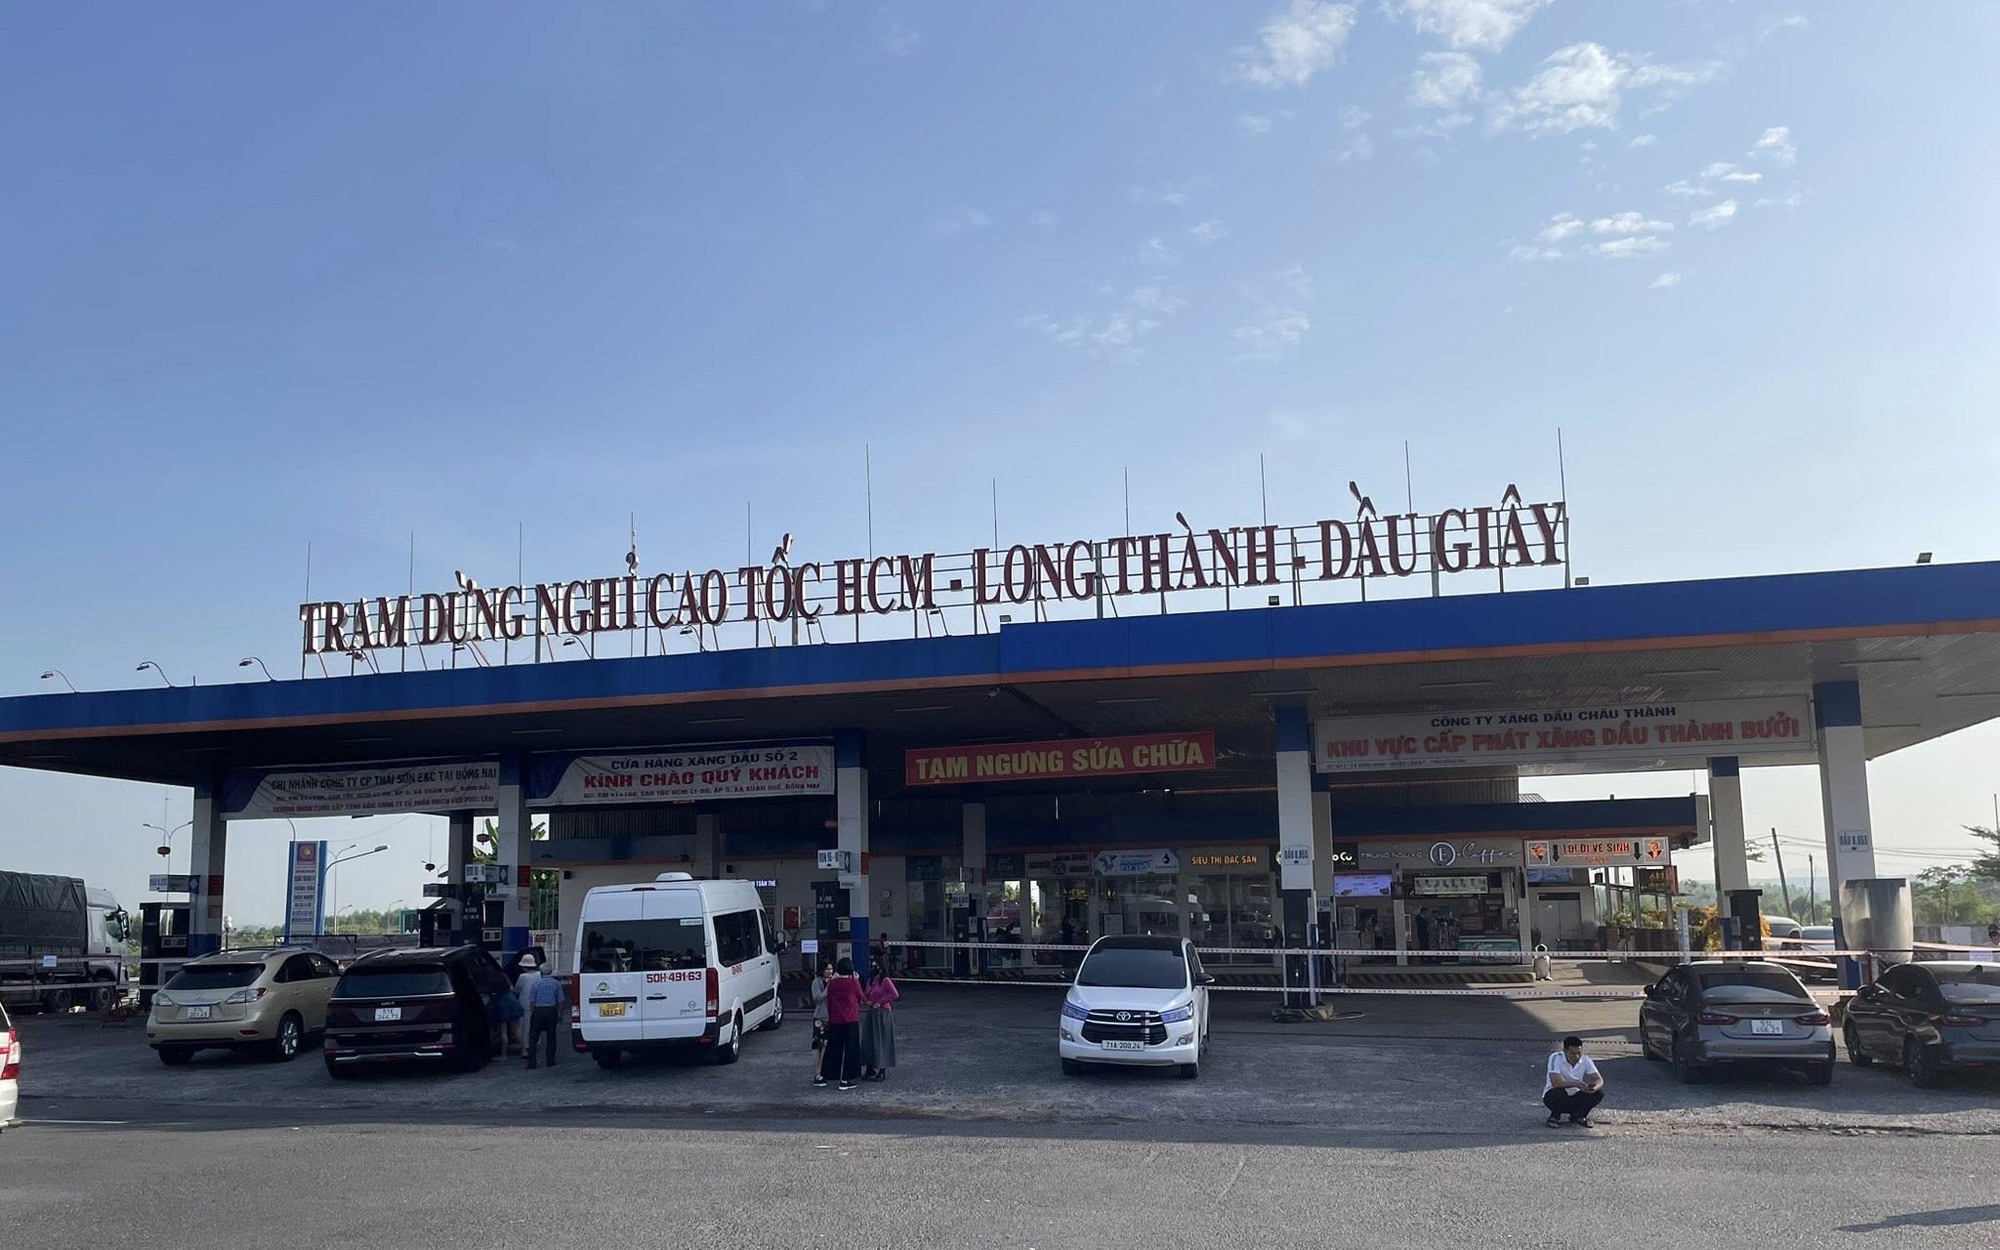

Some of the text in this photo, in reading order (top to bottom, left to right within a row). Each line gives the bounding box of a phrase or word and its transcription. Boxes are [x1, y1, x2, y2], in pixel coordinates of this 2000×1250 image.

[420, 570, 527, 645] DỪNG
[535, 551, 638, 636] NGHỈ
[648, 570, 728, 628] CAO
[738, 532, 823, 622] TỐC
[834, 553, 937, 615] HCM
[974, 540, 1097, 604] LONG
[1108, 511, 1281, 595] THÀNH
[1316, 480, 1418, 580] DẦU
[1434, 484, 1566, 573] GIÂY
[1430, 715, 1470, 728] CÔNG
[1474, 715, 1493, 726] TY
[1623, 705, 1676, 719] THÀNH
[1326, 711, 1800, 760] KHU VỰC CẤP PHÁT XĂNG DẦU THÀNH BƯỞI
[788, 751, 798, 761] 2
[916, 739, 1204, 783] TẠM NGƯNG SỬA CHỮA
[346, 776, 358, 787] TY
[360, 775, 372, 787] CP
[584, 763, 819, 789] KÍNH CHÀO QUÝ KHÁCH
